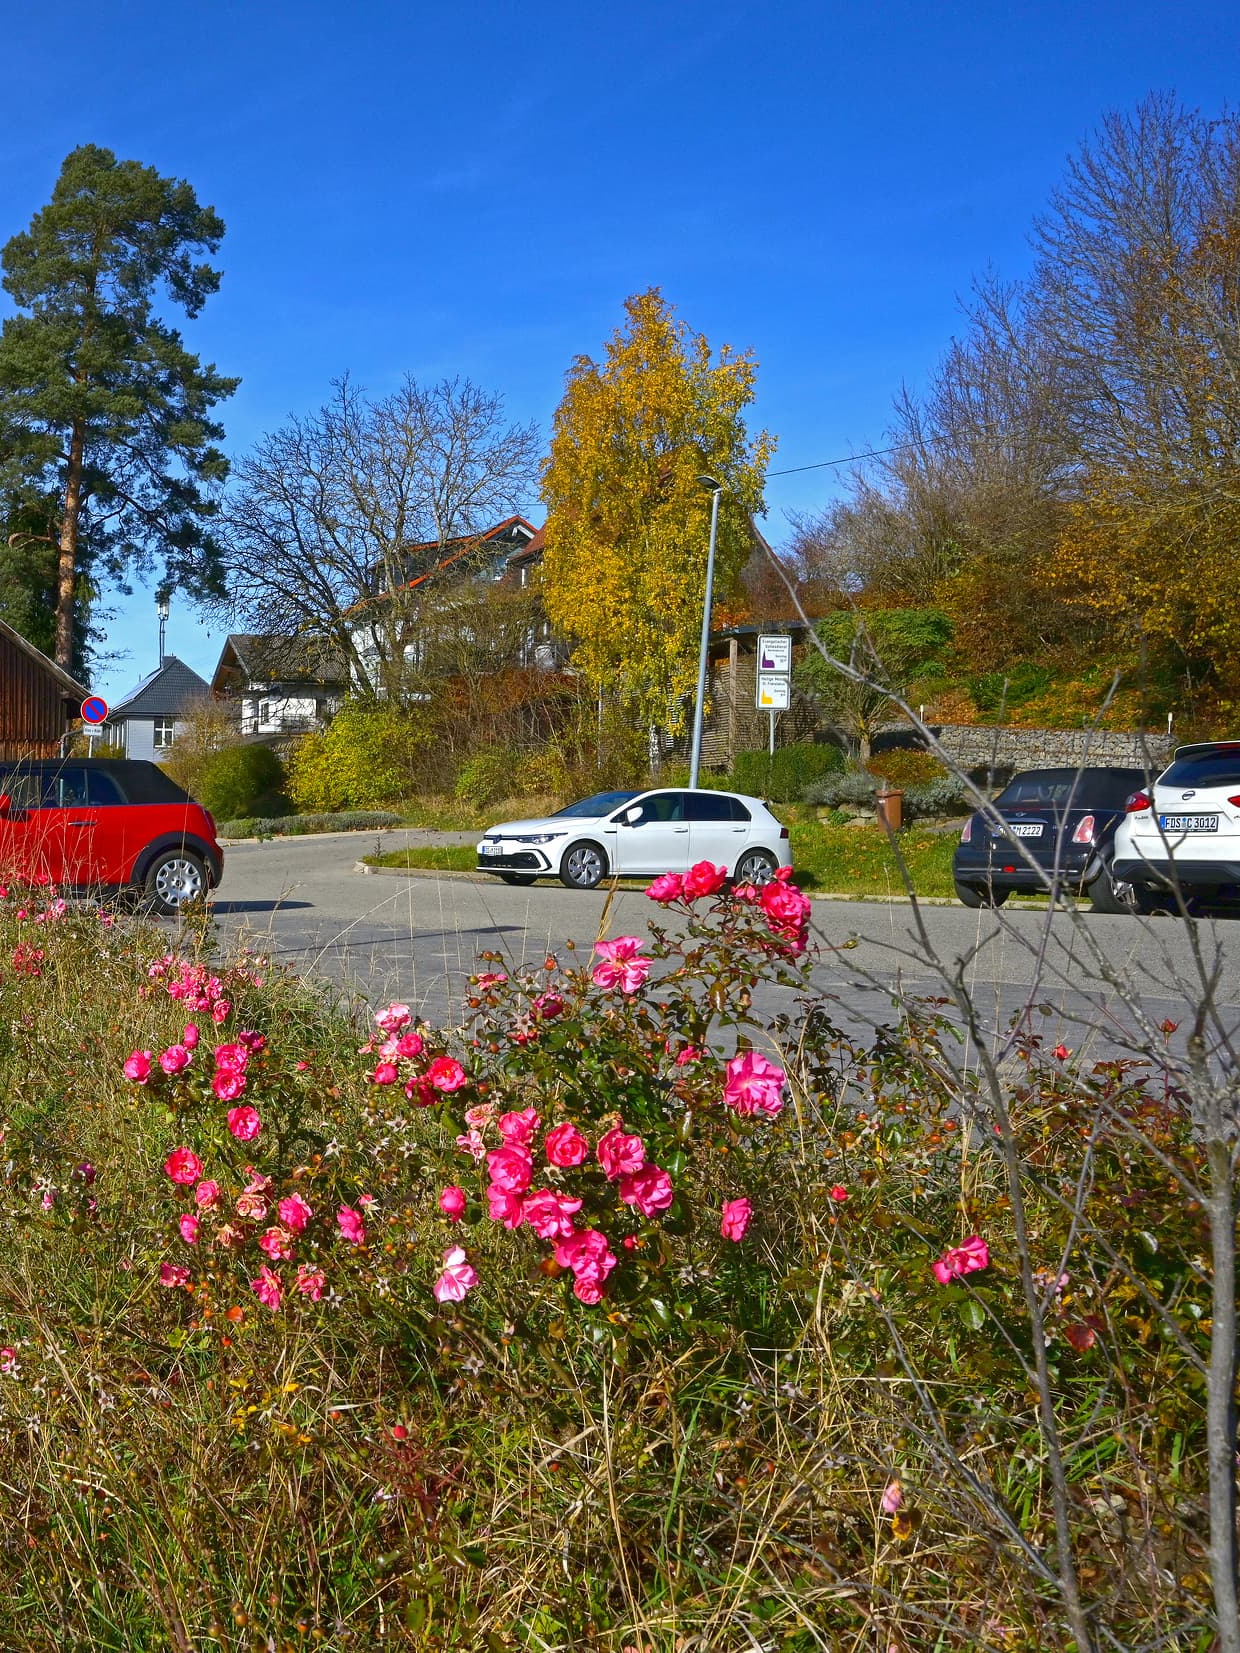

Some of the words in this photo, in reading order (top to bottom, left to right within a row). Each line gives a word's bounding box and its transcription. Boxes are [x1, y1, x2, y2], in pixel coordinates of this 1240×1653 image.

[1165, 817, 1181, 829] FDS
[1187, 817, 1192, 828] C
[1194, 817, 1216, 828] 3012
